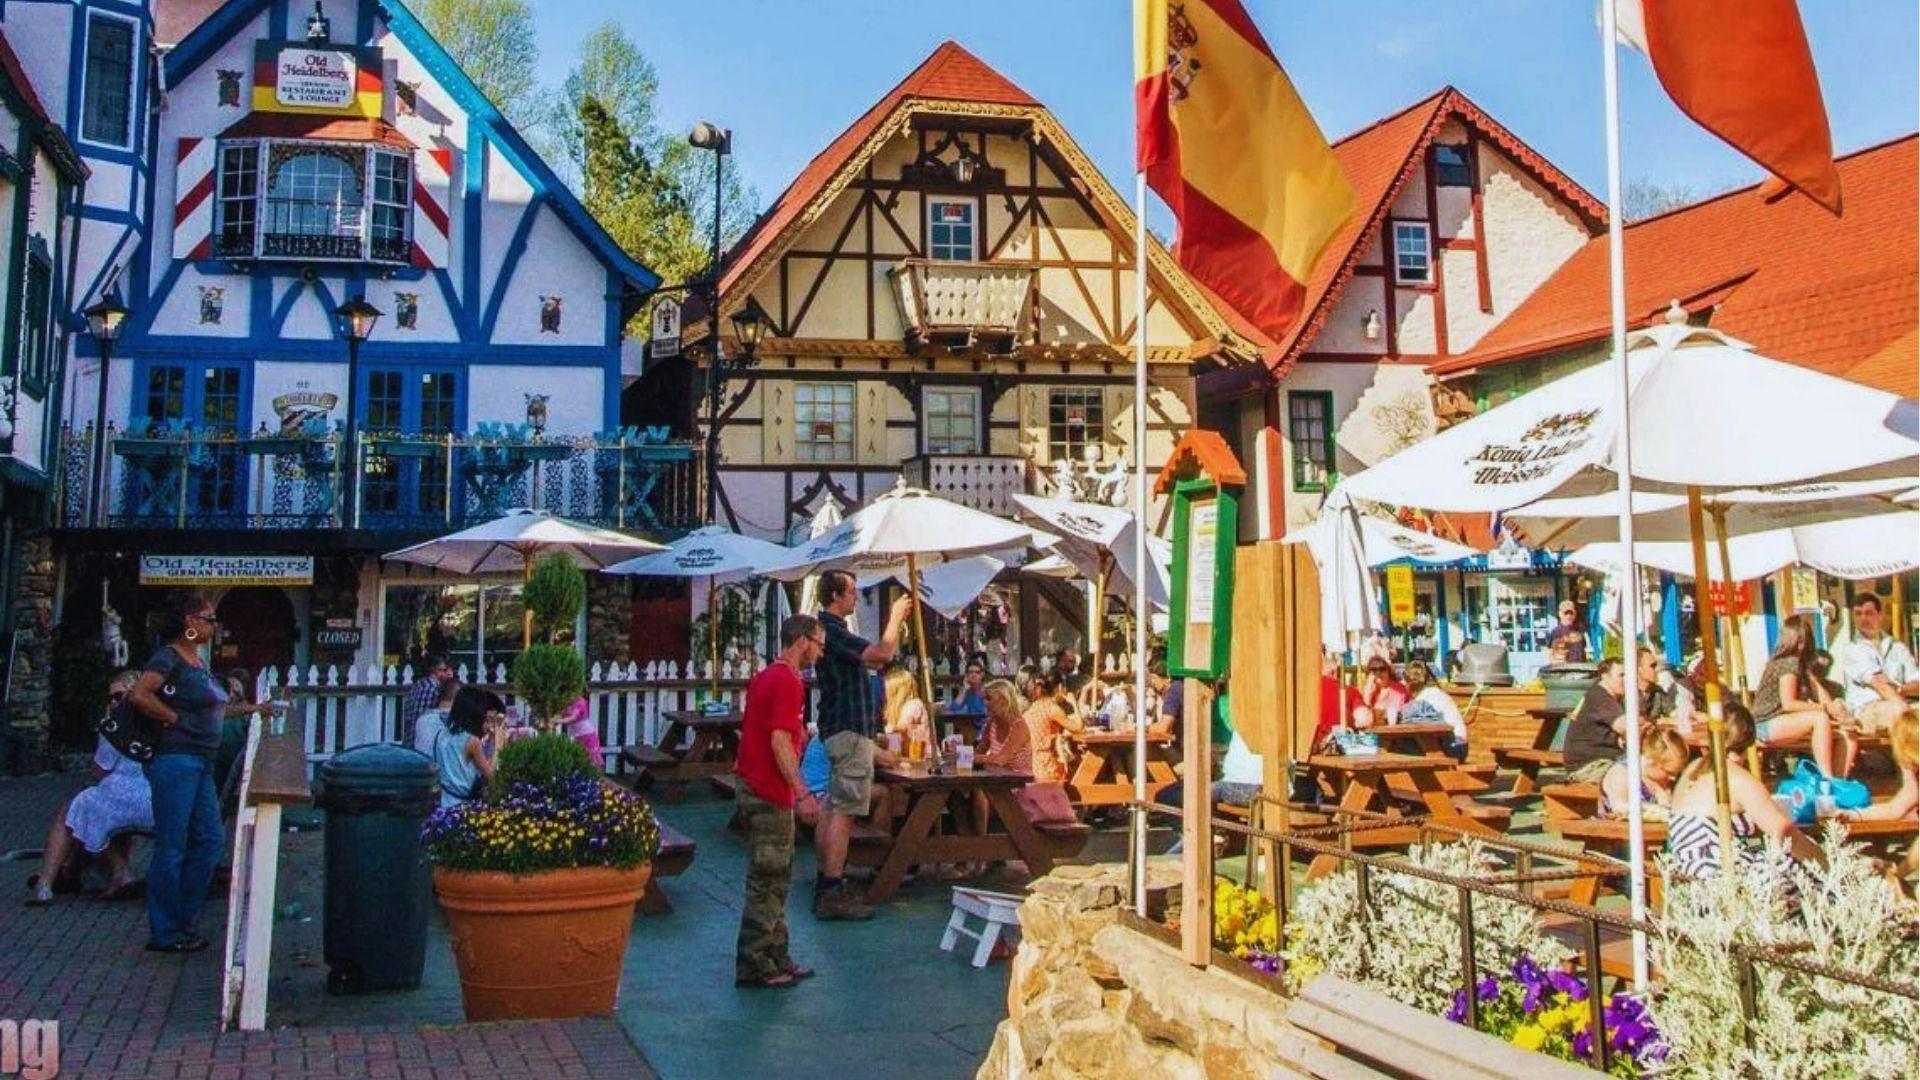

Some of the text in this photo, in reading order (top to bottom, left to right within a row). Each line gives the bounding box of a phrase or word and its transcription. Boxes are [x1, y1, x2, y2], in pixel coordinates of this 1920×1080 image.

[304, 54, 327, 66] Old
[281, 63, 349, 81] Heidelberg
[281, 86, 347, 96] RESTAURANT
[145, 557, 310, 572] Old Heidelberg
[167, 568, 286, 577] GERMAN RESTAURANT
[317, 630, 361, 644] CLOSED
